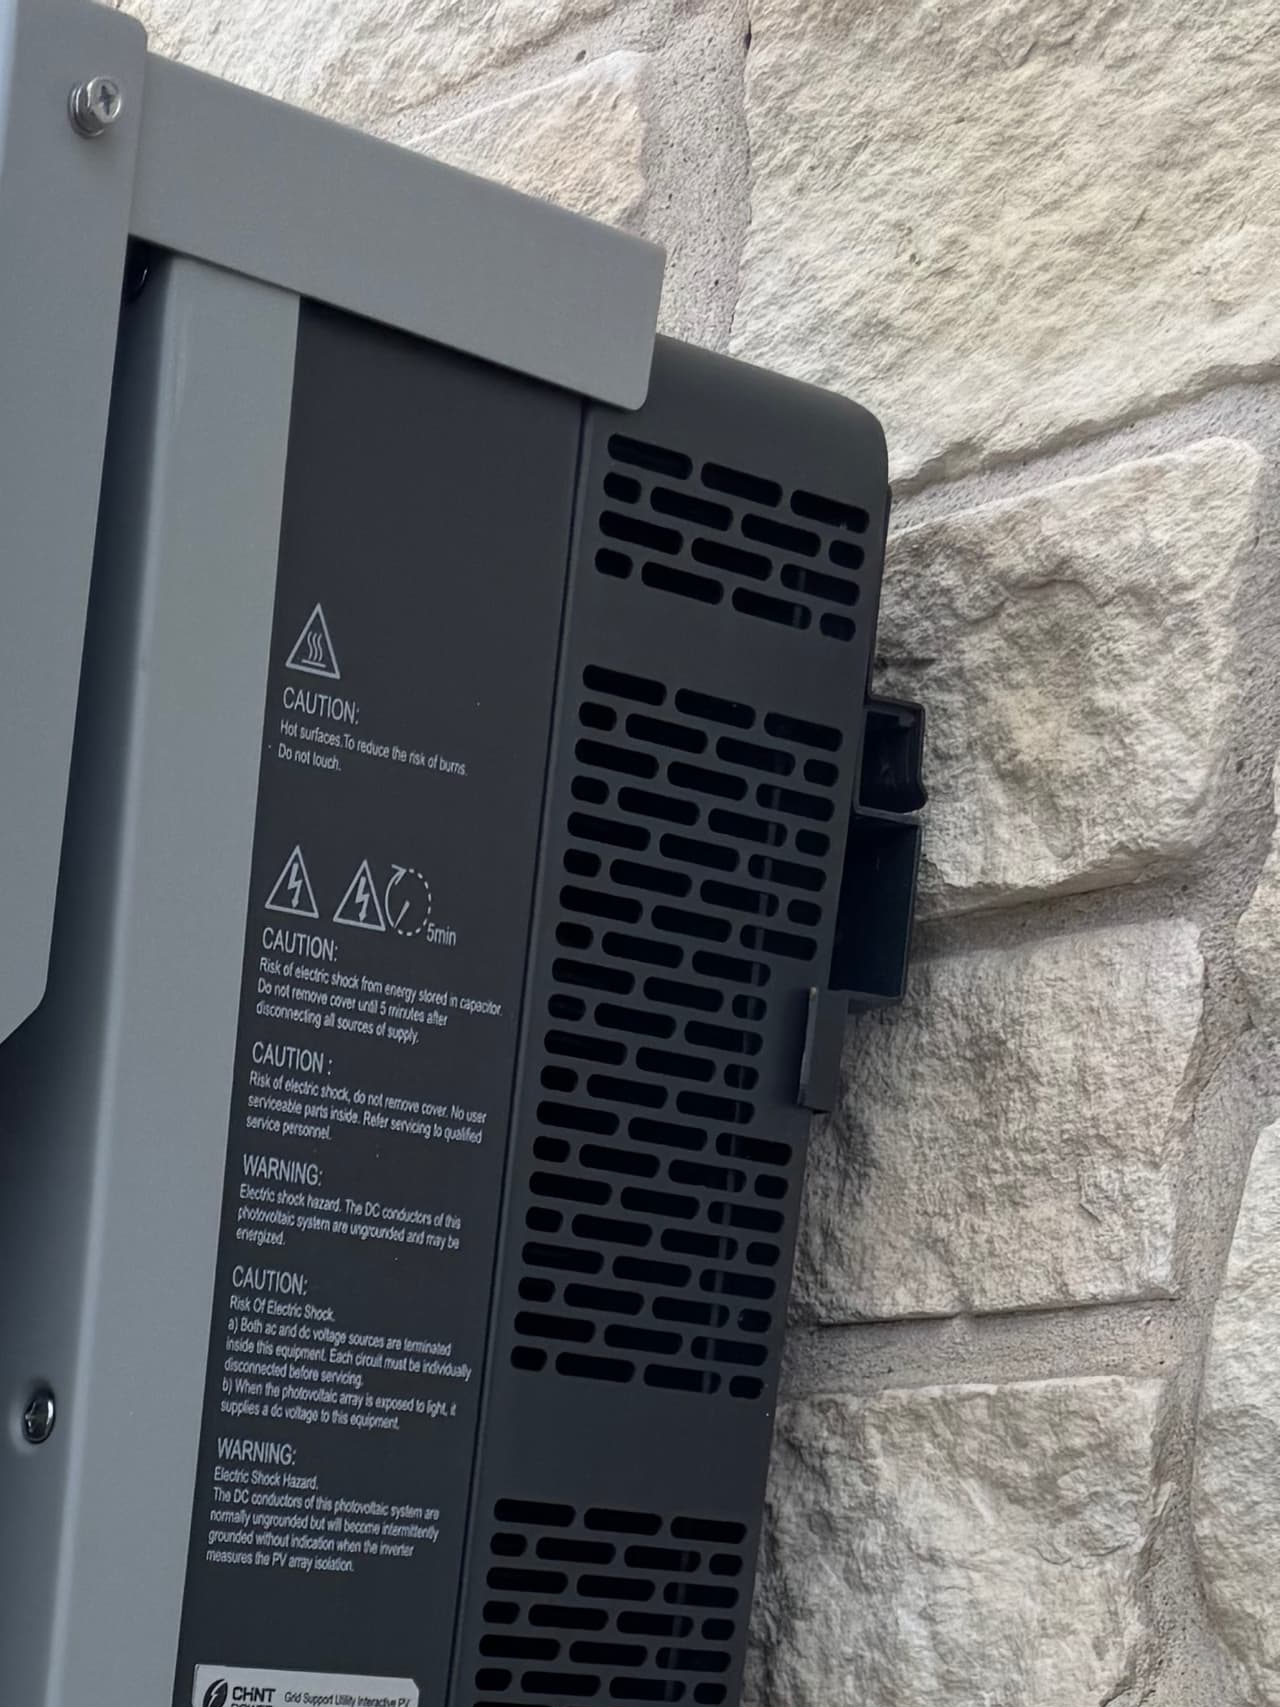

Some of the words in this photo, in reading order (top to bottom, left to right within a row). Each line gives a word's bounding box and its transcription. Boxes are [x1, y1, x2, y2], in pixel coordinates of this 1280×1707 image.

[282, 686, 359, 725] CAUTION:
[261, 926, 338, 962] CAUTION:
[426, 921, 456, 946] 5min
[243, 1153, 323, 1186] WARNING:
[231, 1264, 308, 1296] CAUTION:
[217, 1436, 296, 1465] WARNING:
[231, 1684, 276, 1704] CHNT
